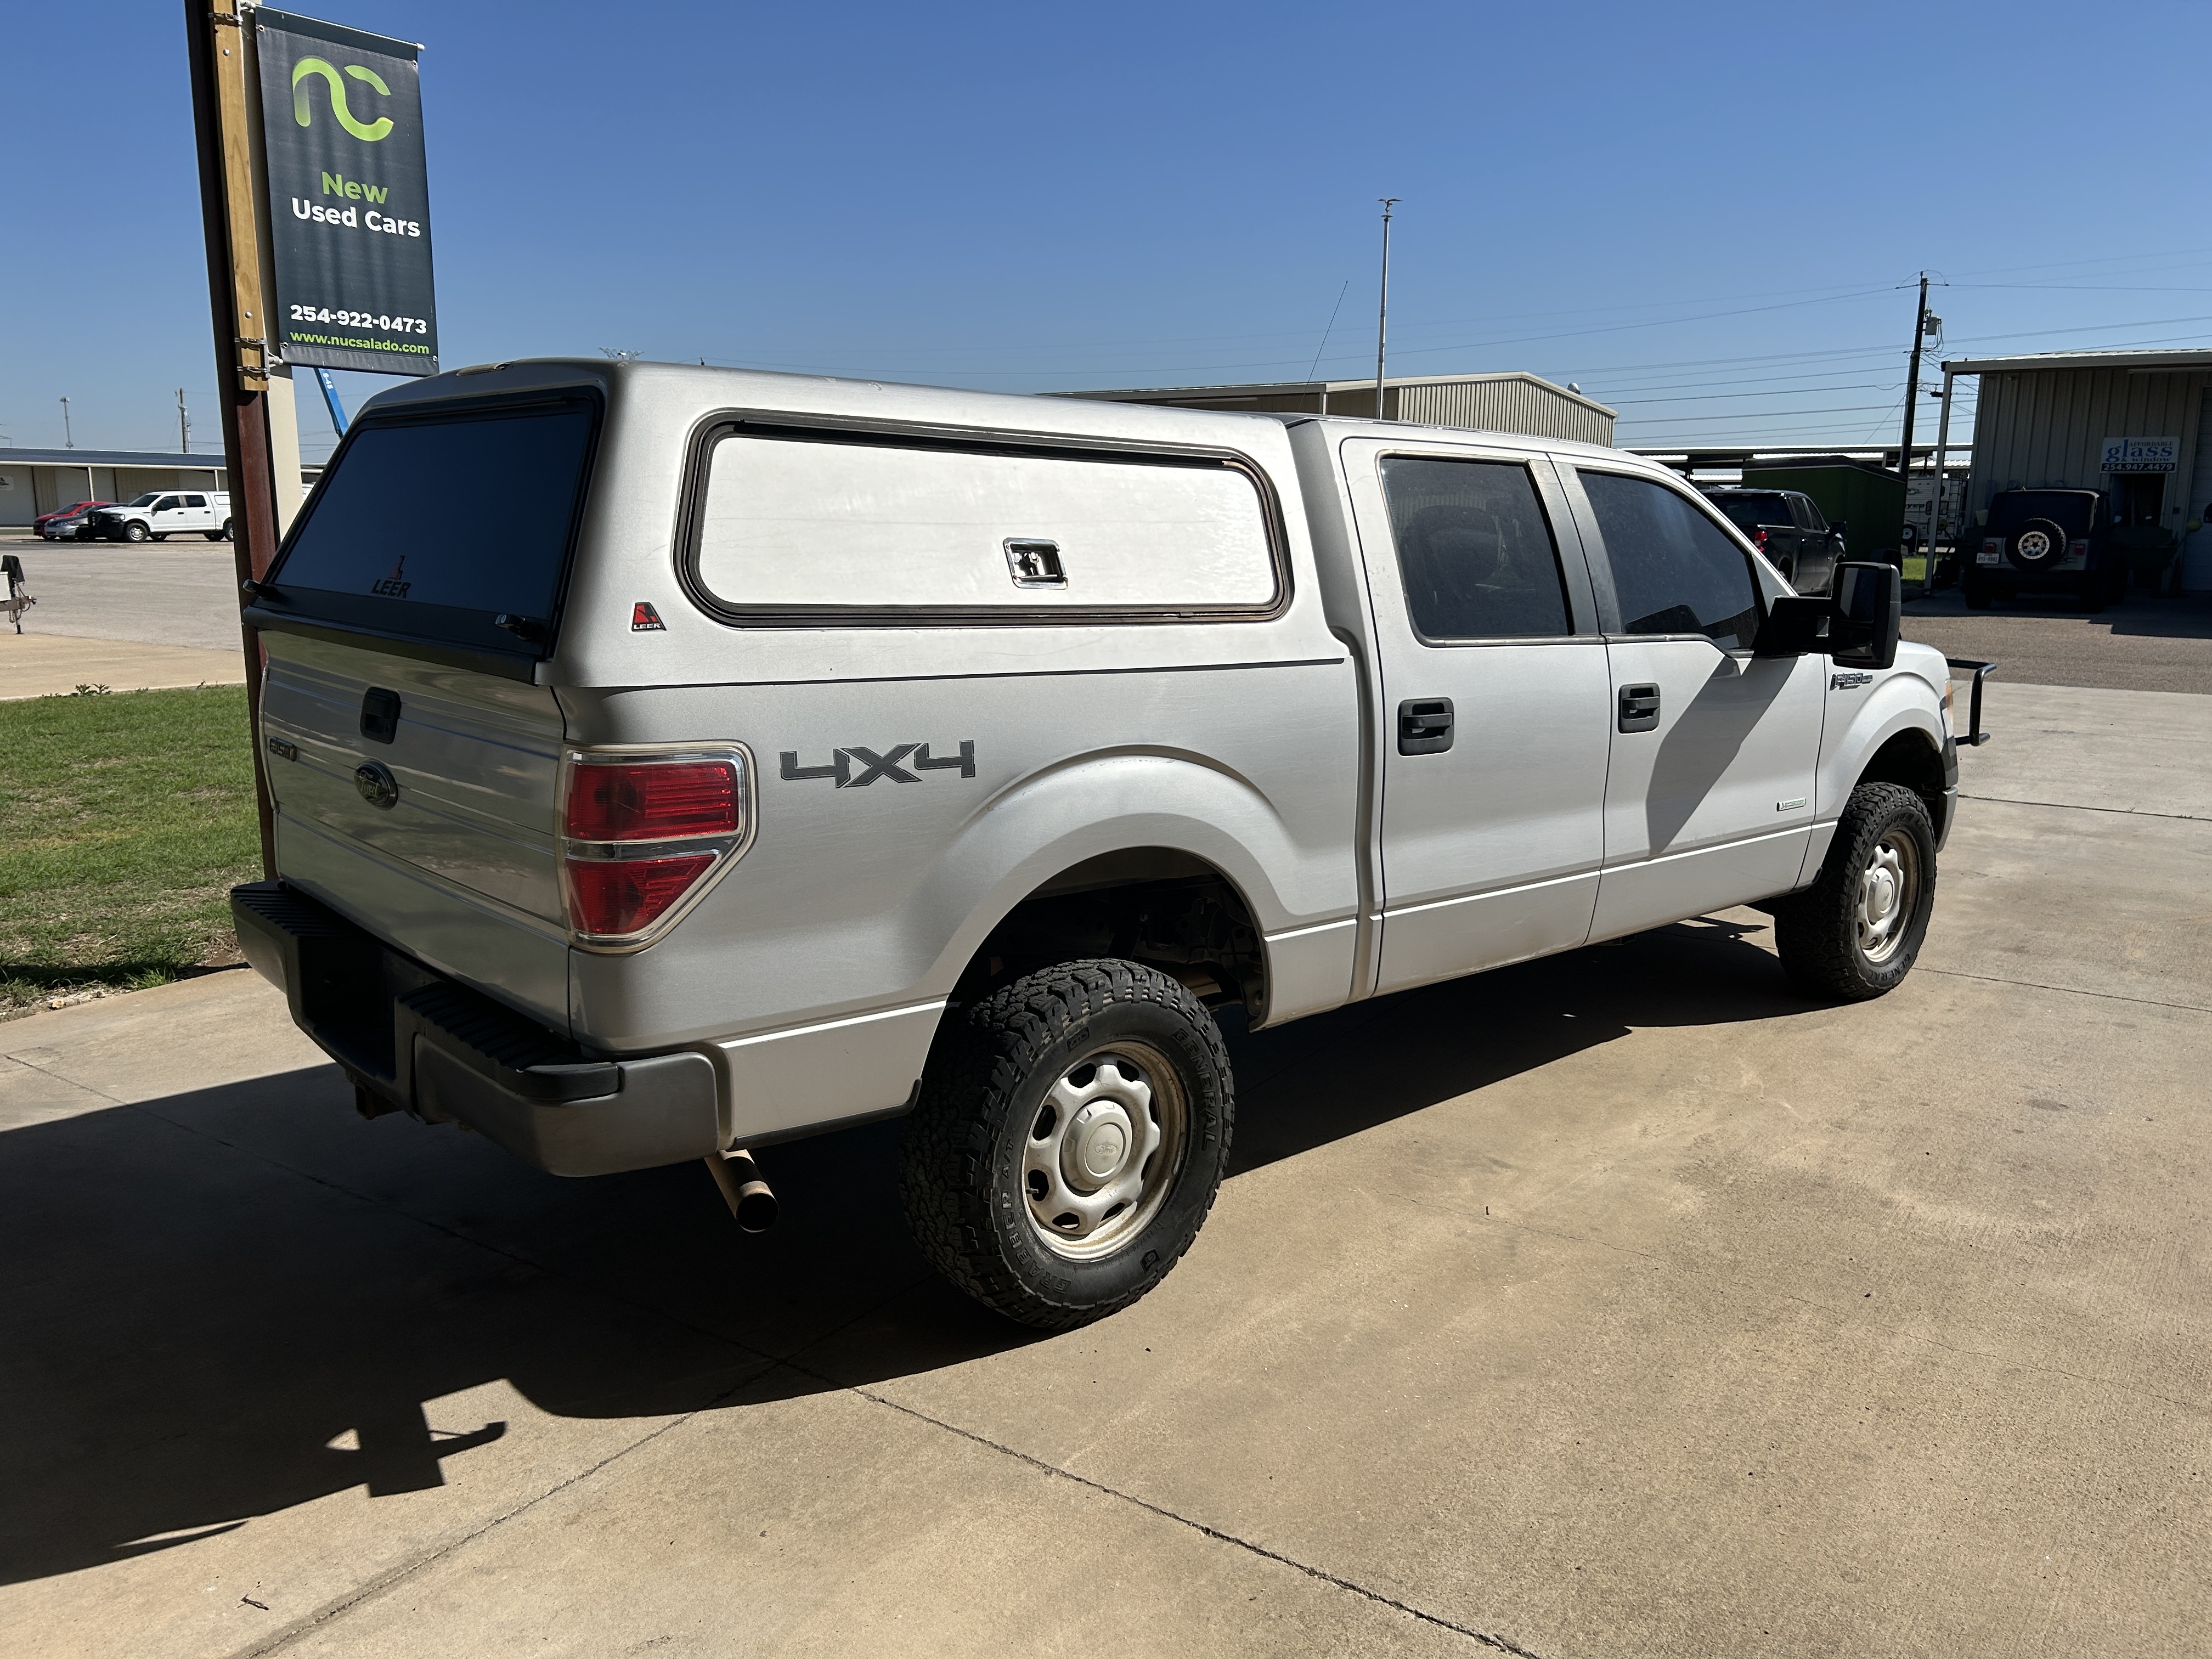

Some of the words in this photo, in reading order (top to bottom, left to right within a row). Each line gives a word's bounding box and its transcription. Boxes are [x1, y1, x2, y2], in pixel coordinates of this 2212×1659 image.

[321, 171, 388, 204] New
[291, 197, 357, 228] Used
[364, 210, 421, 238] Cars
[290, 304, 427, 334] 254-922-0473
[289, 331, 430, 355] www.nucsalado.com
[2106, 439, 2172, 462] glass
[371, 579, 411, 599] LEER
[1170, 1027, 1217, 1150] GENERAL
[1001, 1191, 1071, 1294] GRABBER
